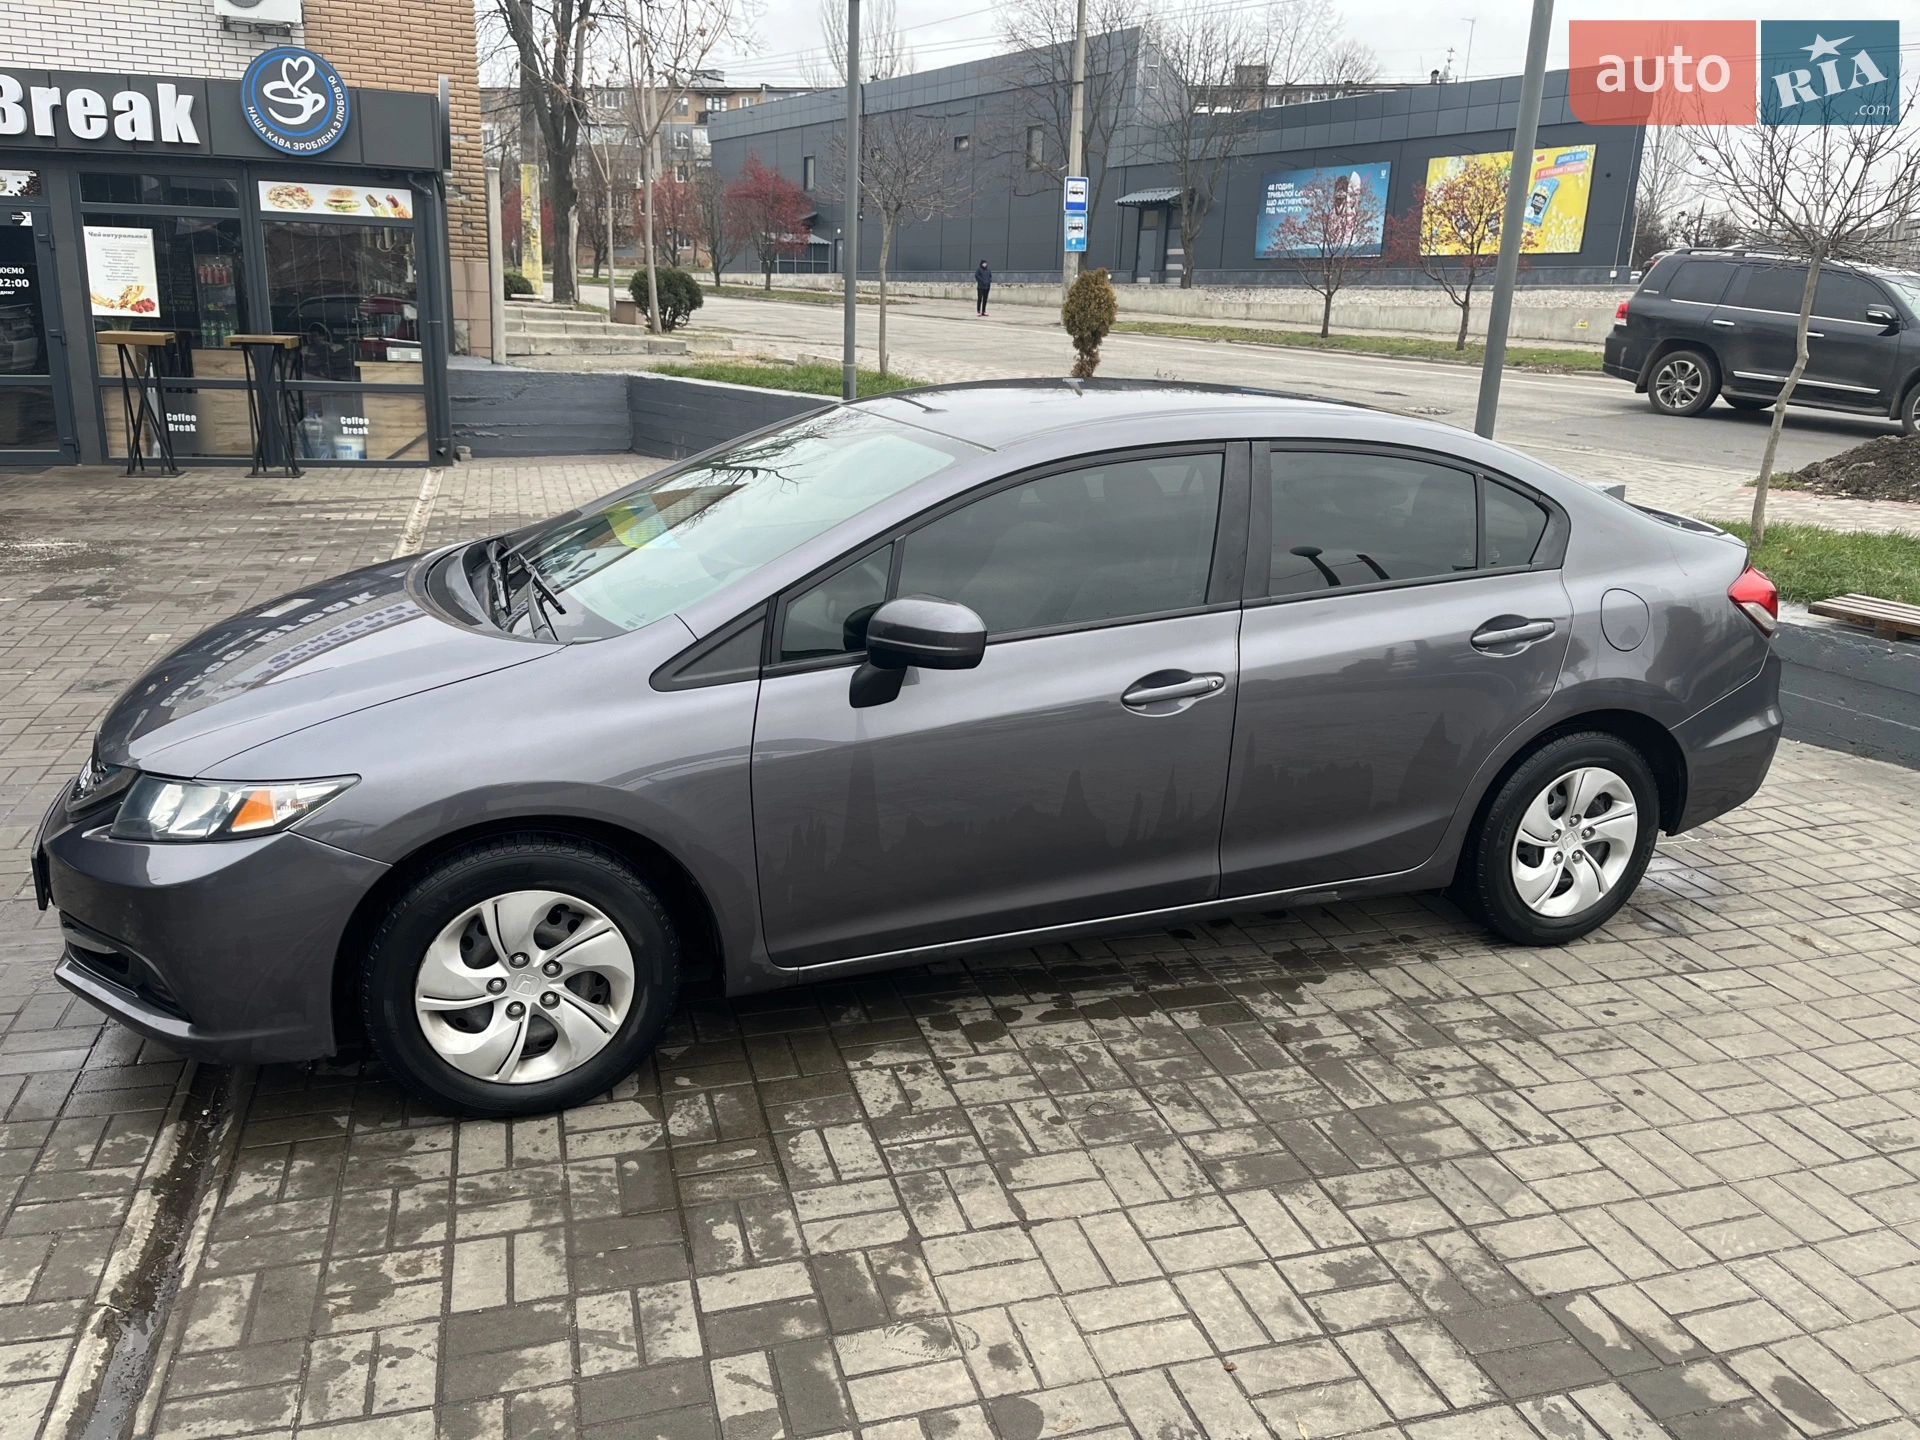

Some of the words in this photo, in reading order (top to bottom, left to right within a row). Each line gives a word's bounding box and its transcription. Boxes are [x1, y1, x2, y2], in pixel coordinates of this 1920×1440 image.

[0, 74, 200, 144] Break
[247, 106, 267, 134] НАША
[266, 131, 291, 150] КАВА
[293, 128, 338, 151] ЗРОБЛЕНА
[166, 413, 197, 422] Coffee
[340, 416, 370, 425] Coffee
[168, 423, 197, 432] Break
[342, 426, 369, 435] Break
